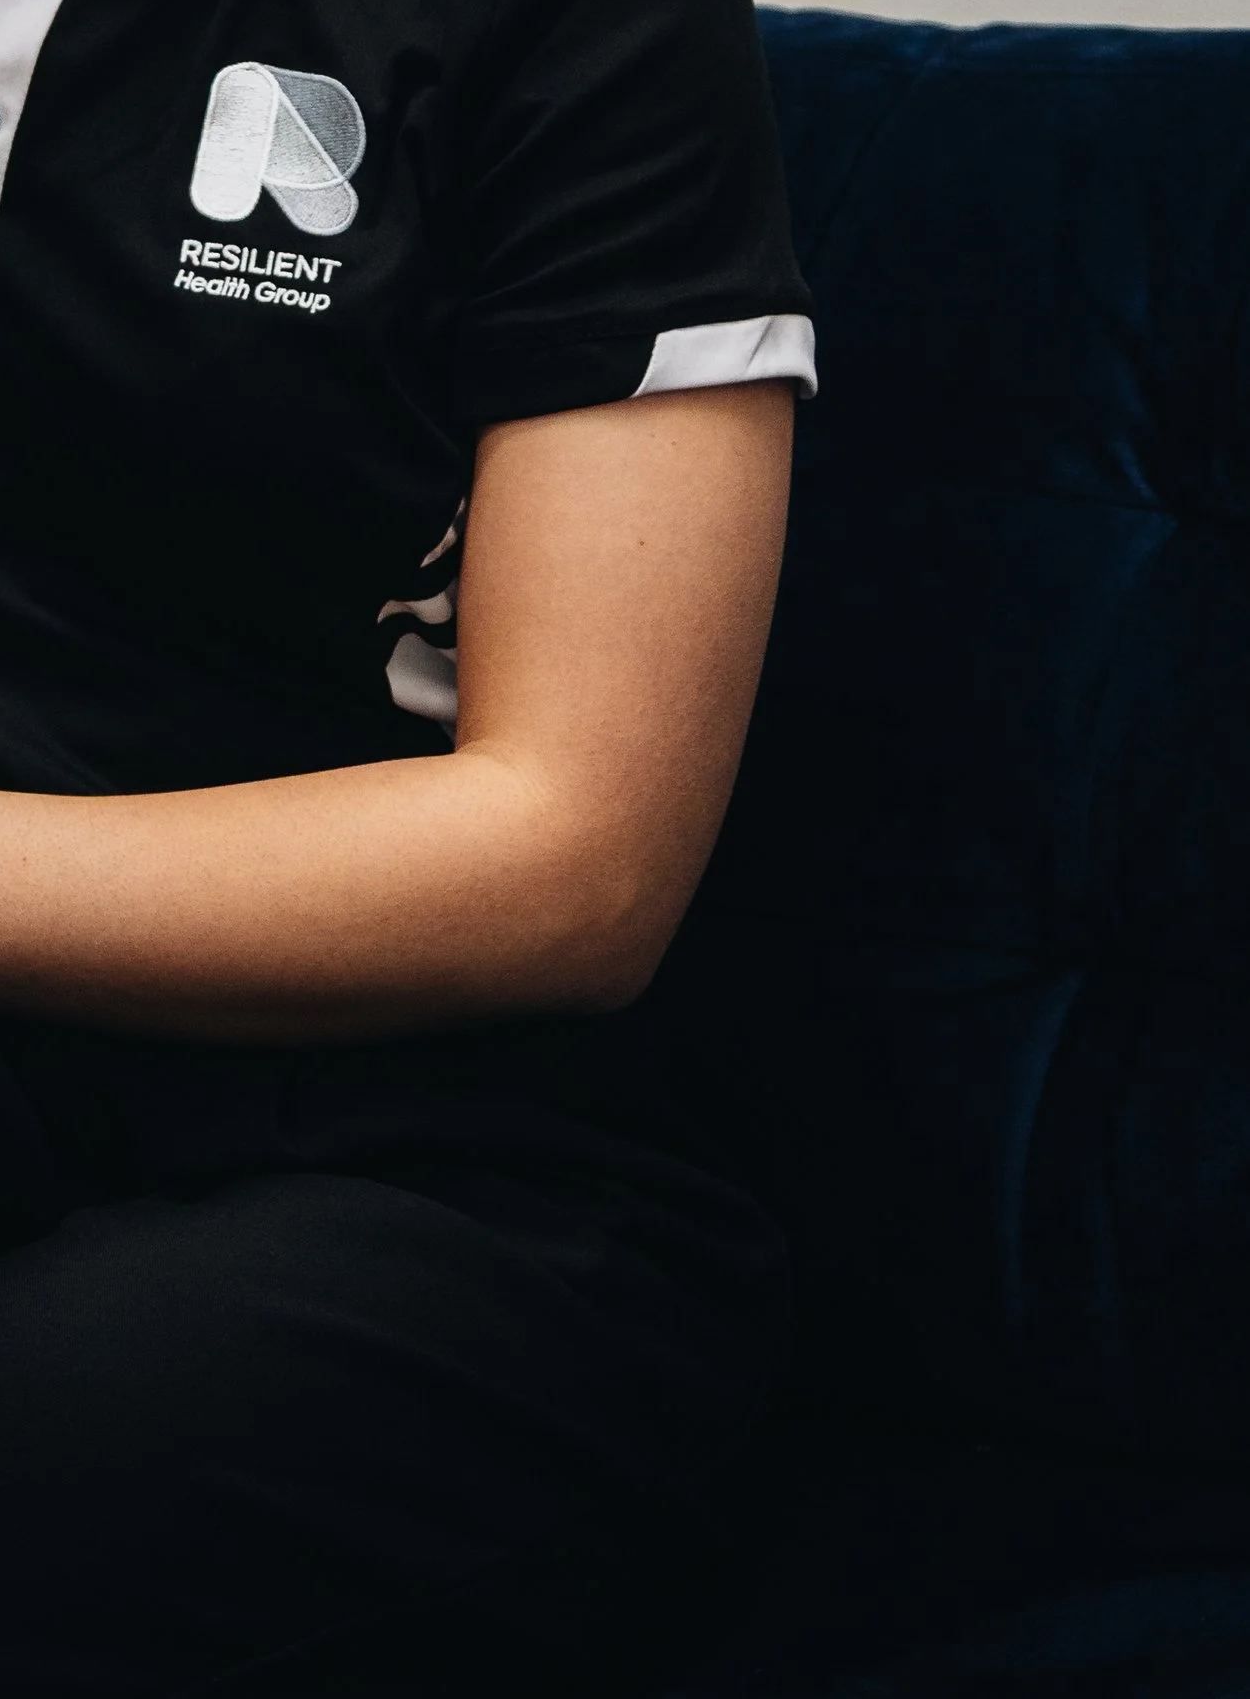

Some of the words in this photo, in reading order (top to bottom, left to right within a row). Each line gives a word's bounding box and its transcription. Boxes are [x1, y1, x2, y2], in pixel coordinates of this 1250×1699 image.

[179, 238, 342, 283] RESILIENT
[174, 268, 250, 300] Health
[254, 281, 331, 314] Group
